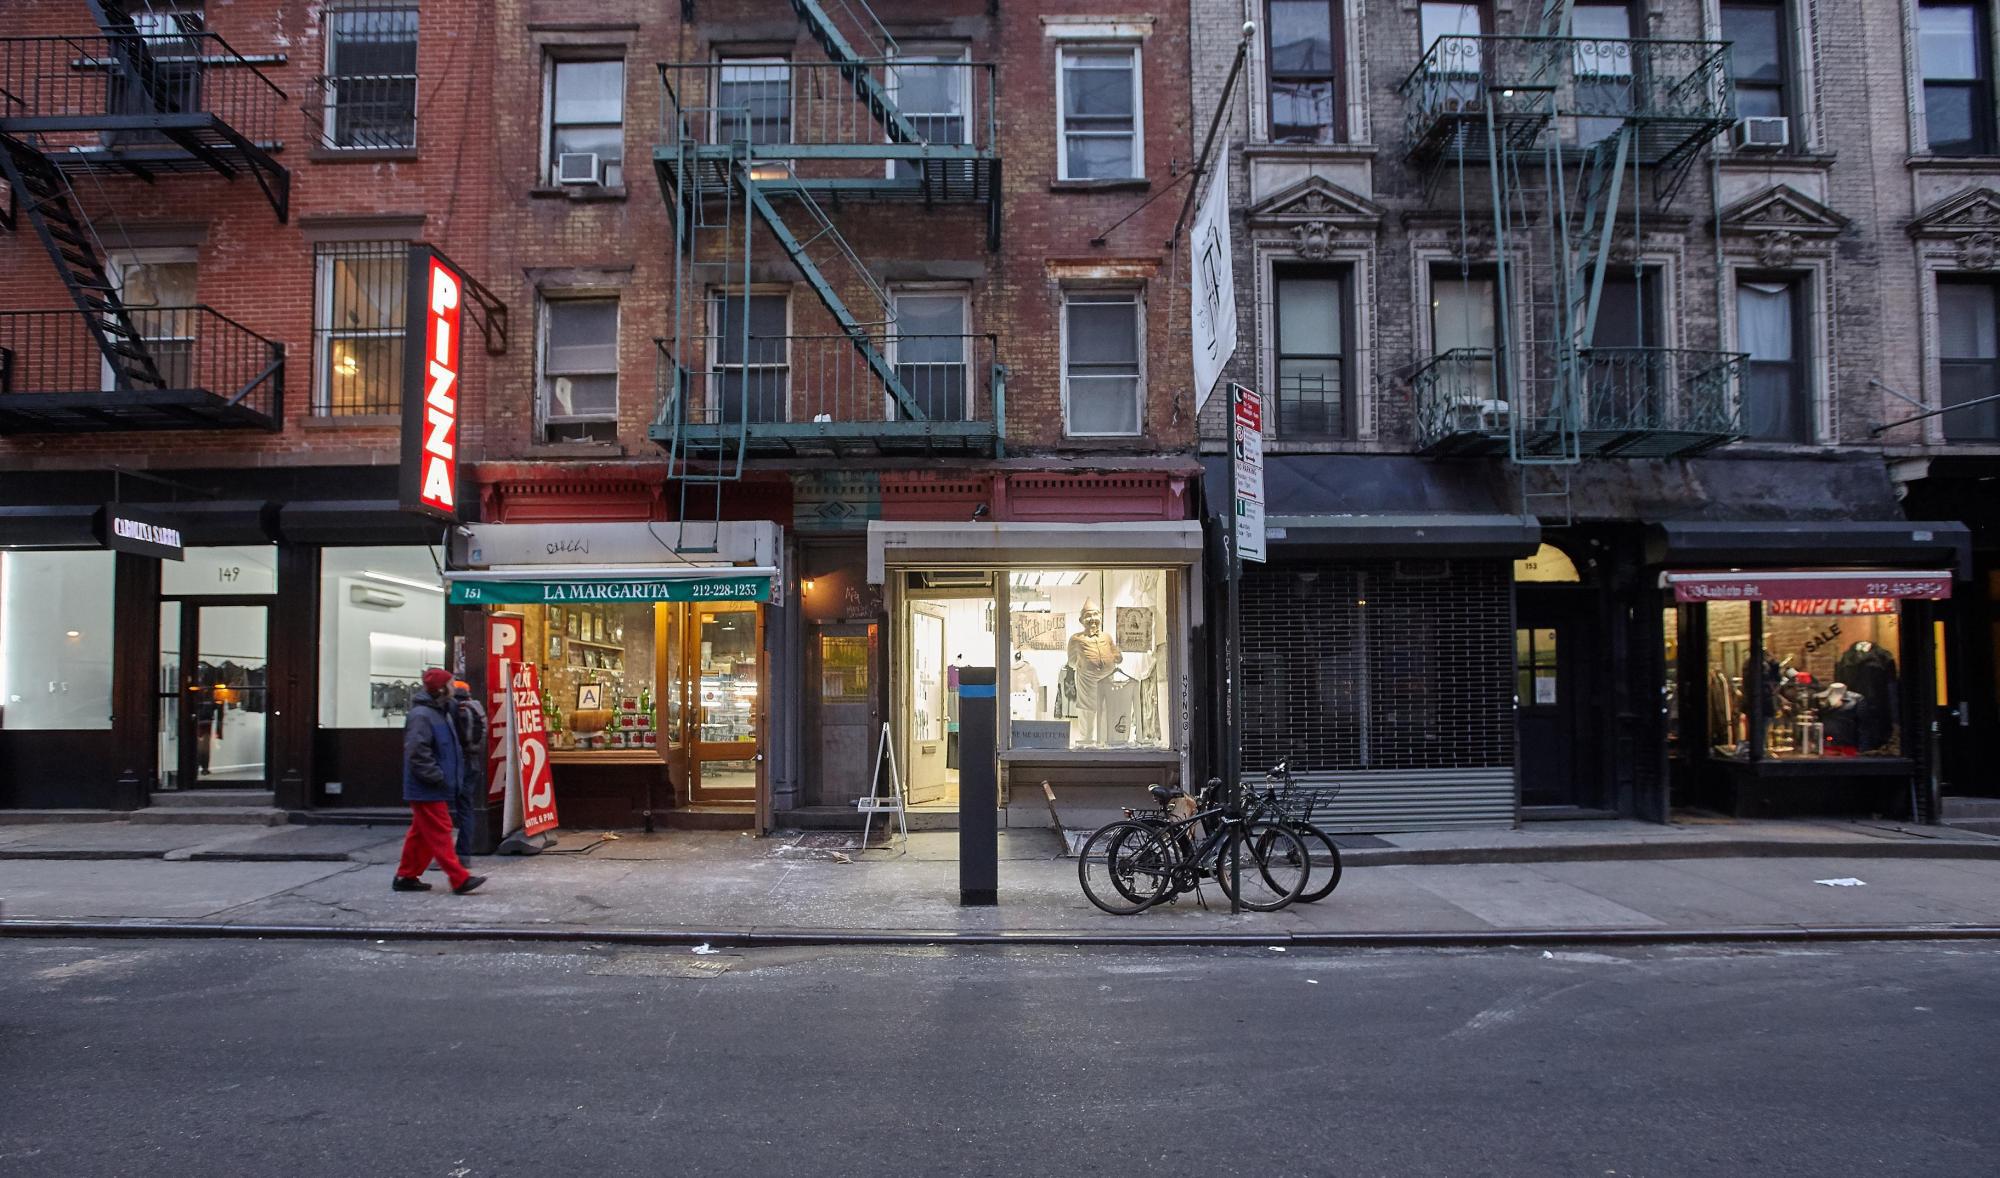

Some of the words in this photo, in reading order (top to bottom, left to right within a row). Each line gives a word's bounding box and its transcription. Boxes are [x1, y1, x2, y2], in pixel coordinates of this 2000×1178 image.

[426, 266, 458, 506] PIZZA
[219, 566, 241, 583] 149
[1525, 562, 1537, 570] 153
[464, 588, 481, 598] 151
[543, 585, 565, 600] LA
[569, 583, 670, 600] MARGARITA
[692, 583, 757, 597] 212-228-1233
[1804, 623, 1842, 653] SALE
[582, 688, 596, 704] A
